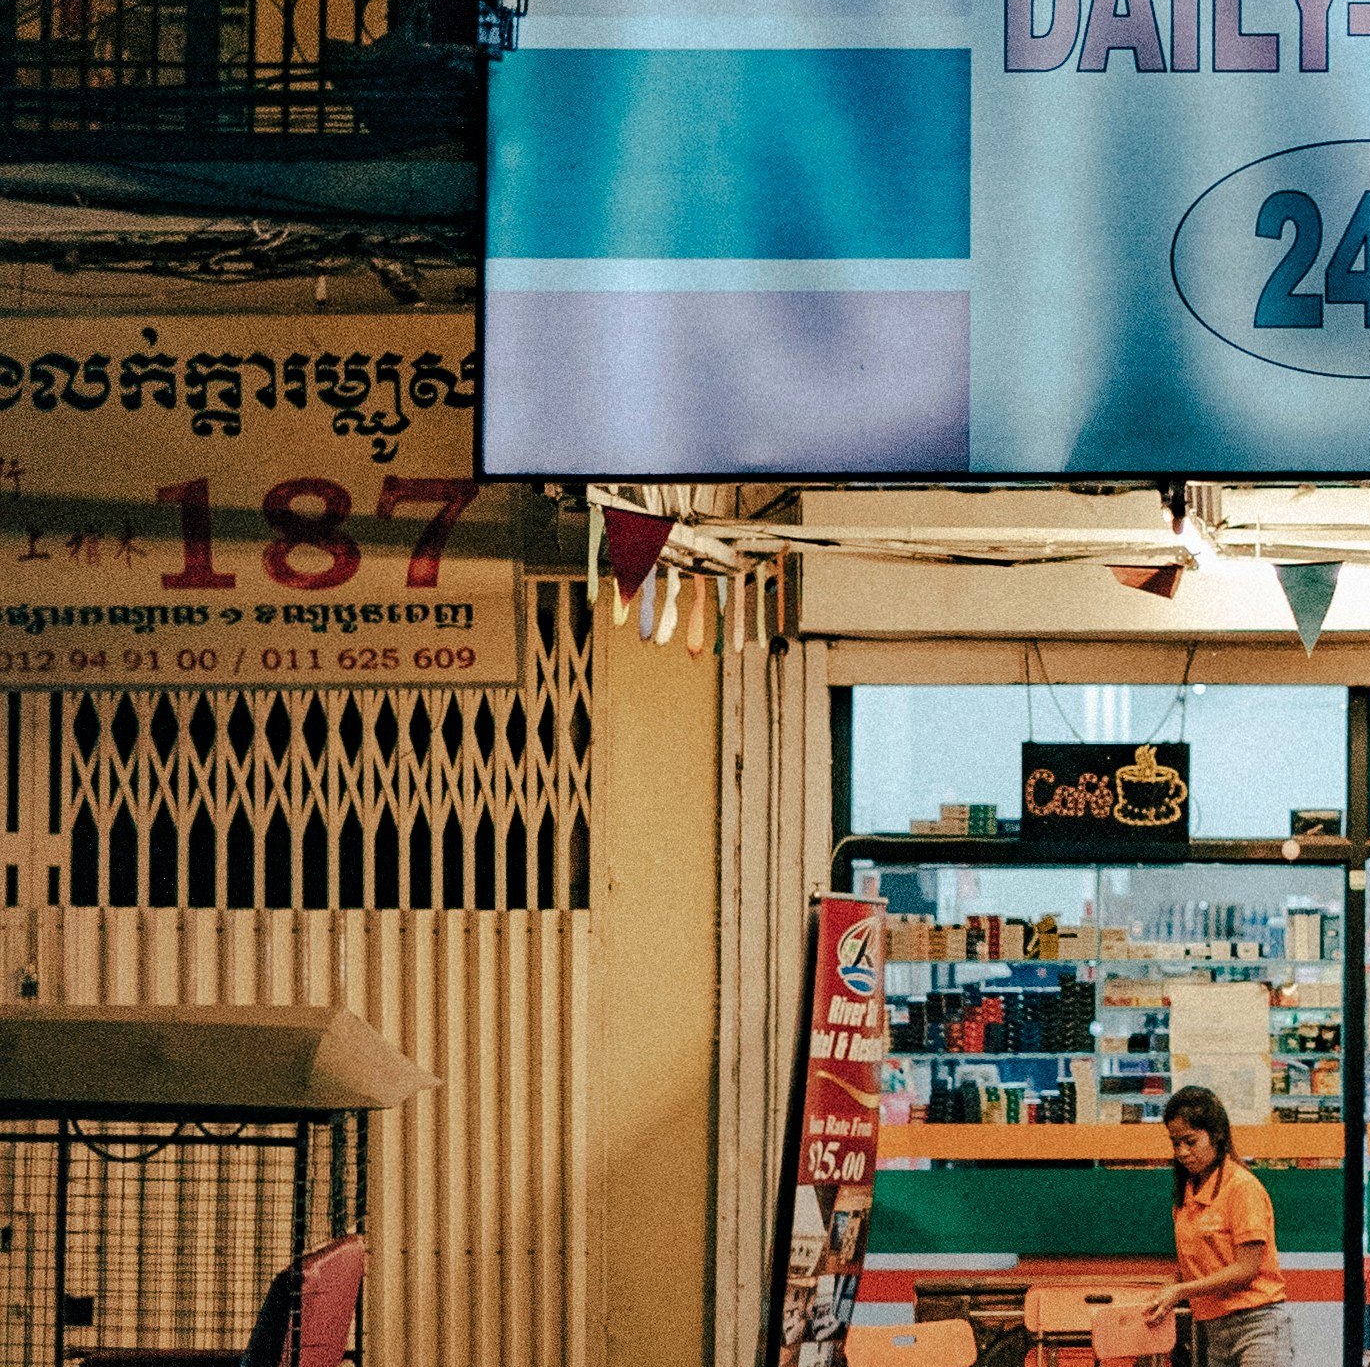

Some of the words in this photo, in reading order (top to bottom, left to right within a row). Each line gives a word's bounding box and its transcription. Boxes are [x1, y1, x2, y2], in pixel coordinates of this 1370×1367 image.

[156, 475, 480, 590] 187
[124, 649, 160, 671] 91
[177, 648, 218, 671] 00
[261, 647, 323, 671] 011
[338, 647, 401, 670] 625
[414, 646, 477, 669] 609
